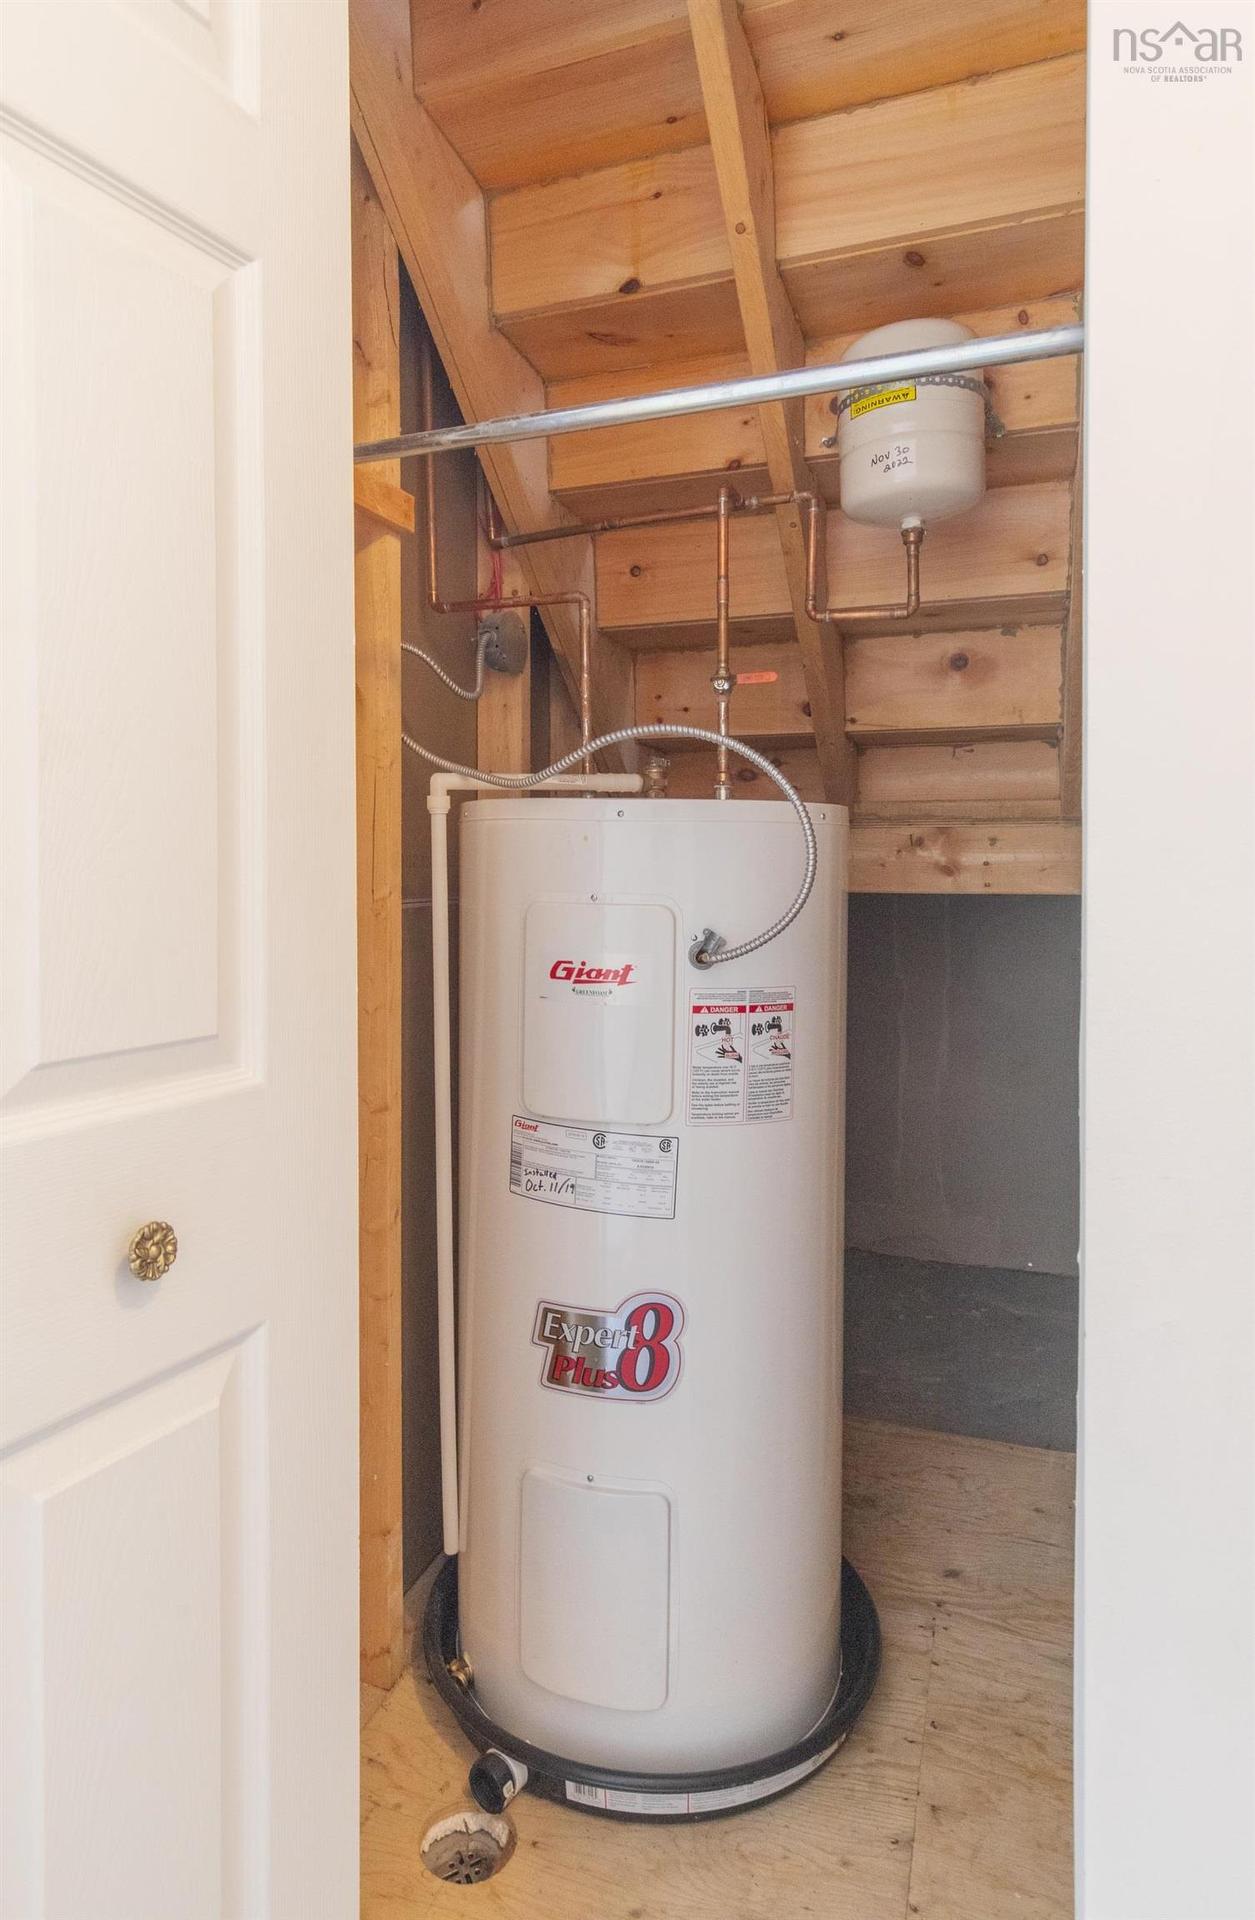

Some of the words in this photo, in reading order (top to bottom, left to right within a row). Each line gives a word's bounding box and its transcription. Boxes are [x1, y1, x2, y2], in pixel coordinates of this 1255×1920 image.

[855, 393, 902, 415] WARNING
[894, 445, 910, 457] 30
[883, 457, 913, 473] 2022
[549, 960, 637, 986] Giant
[763, 1004, 788, 1012] DANGER
[514, 1119, 539, 1132] Giant
[525, 1178, 546, 1192] Oct.
[550, 1177, 575, 1194] 11/19
[542, 1311, 640, 1354] Expert
[552, 1353, 621, 1390] Plus
[615, 1302, 674, 1393] 8
